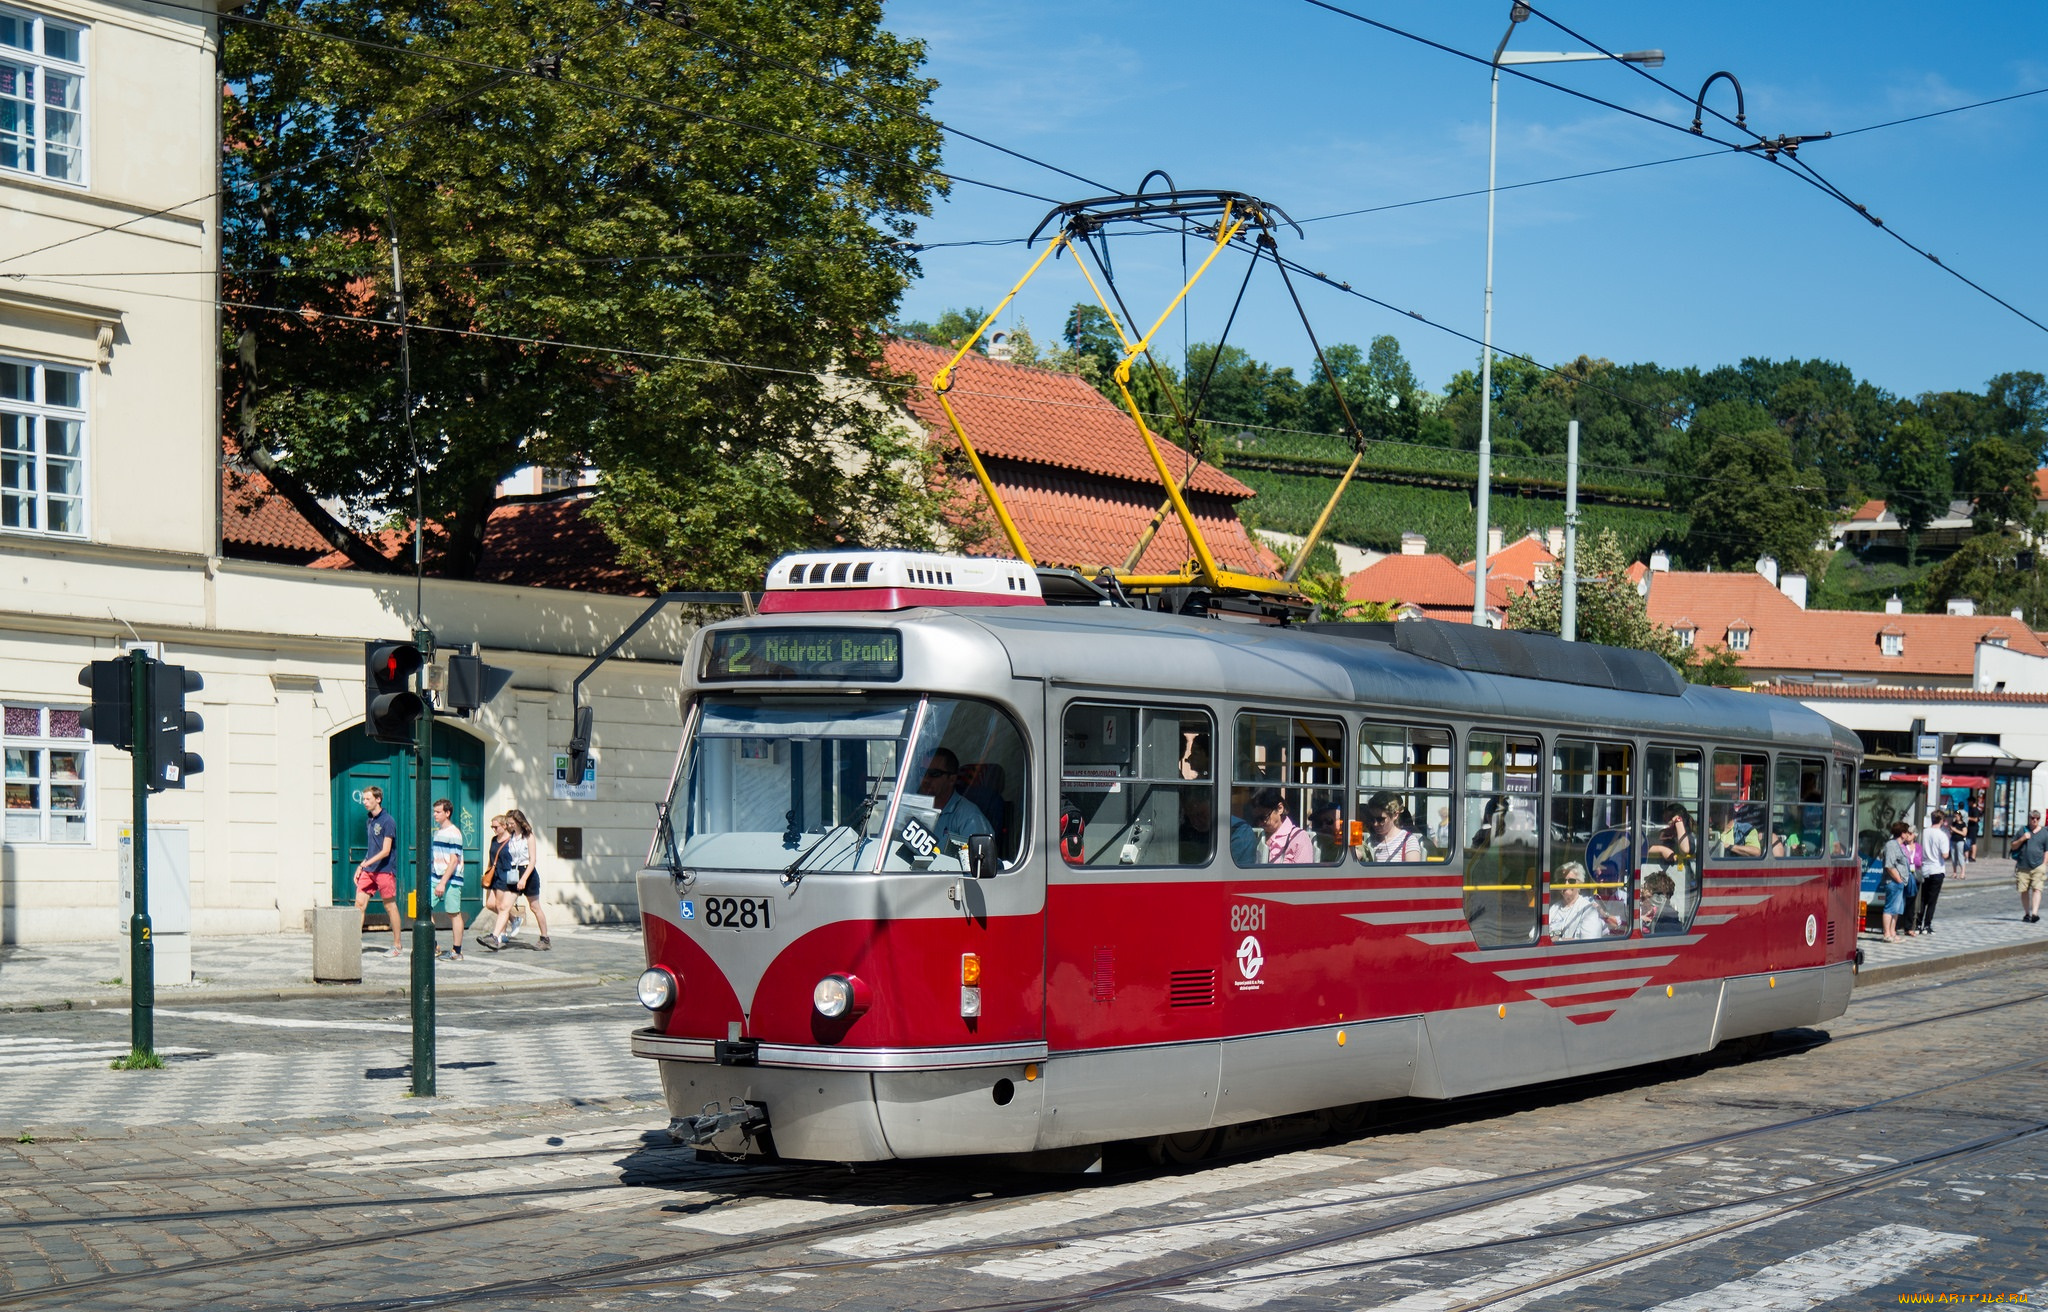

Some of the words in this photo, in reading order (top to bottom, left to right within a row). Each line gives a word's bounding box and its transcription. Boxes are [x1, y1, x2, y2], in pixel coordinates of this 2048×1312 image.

[728, 633, 751, 672] 2
[765, 638, 833, 662] Nádraží
[841, 638, 898, 662] Braník
[902, 820, 937, 856] 505
[705, 897, 771, 929] 8281
[1230, 903, 1266, 932] 8281
[142, 927, 151, 940] 2
